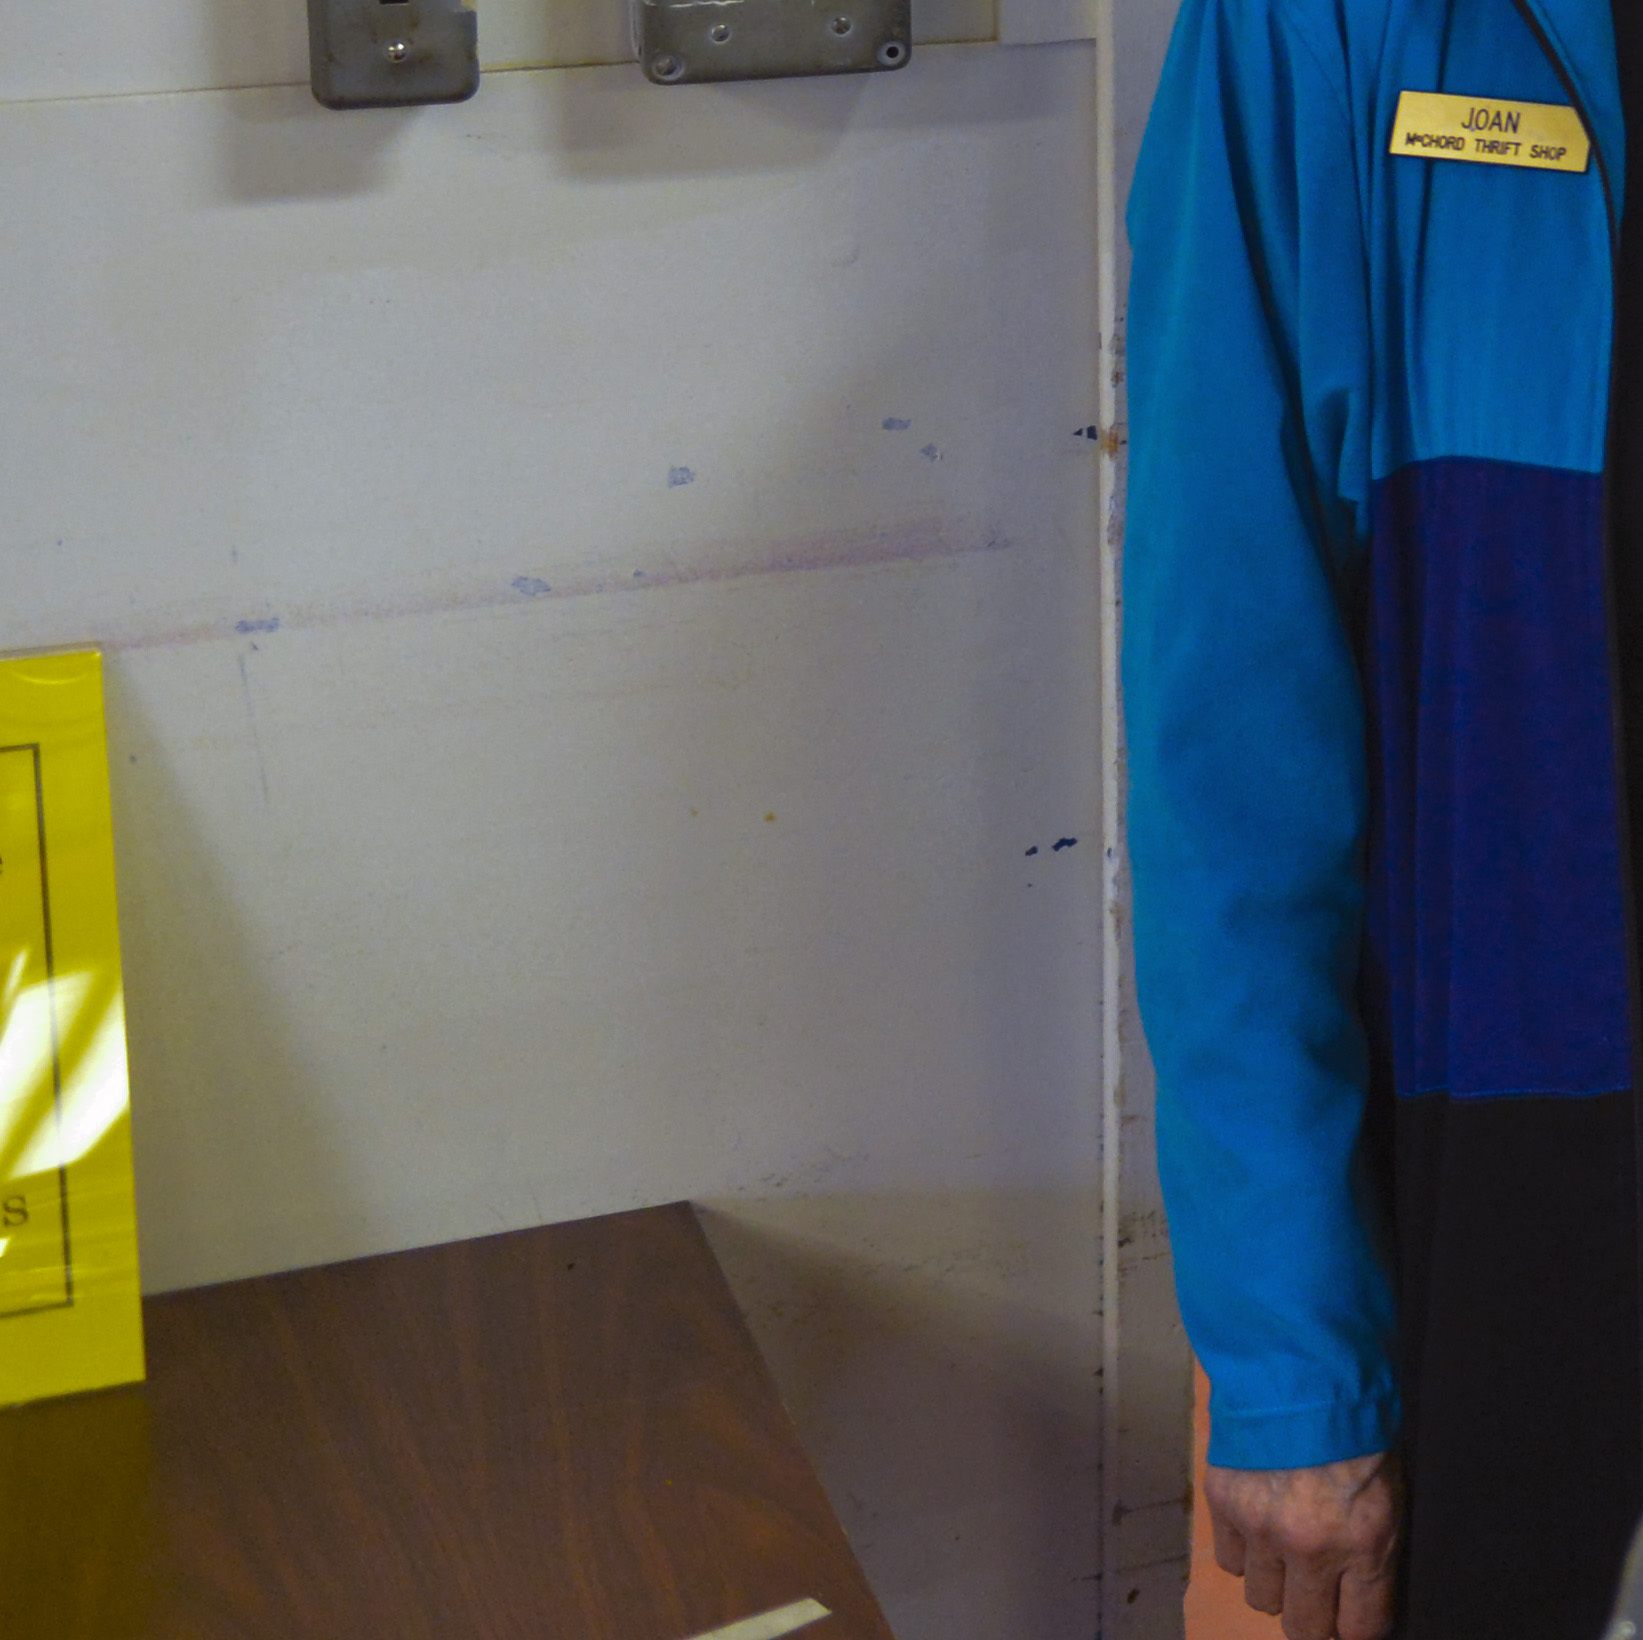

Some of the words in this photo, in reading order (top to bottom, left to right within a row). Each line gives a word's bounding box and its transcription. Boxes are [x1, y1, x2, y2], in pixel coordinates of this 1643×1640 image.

[1461, 107, 1521, 133] JOAN
[1474, 138, 1523, 156] THRIFT
[1529, 144, 1567, 161] SHOP
